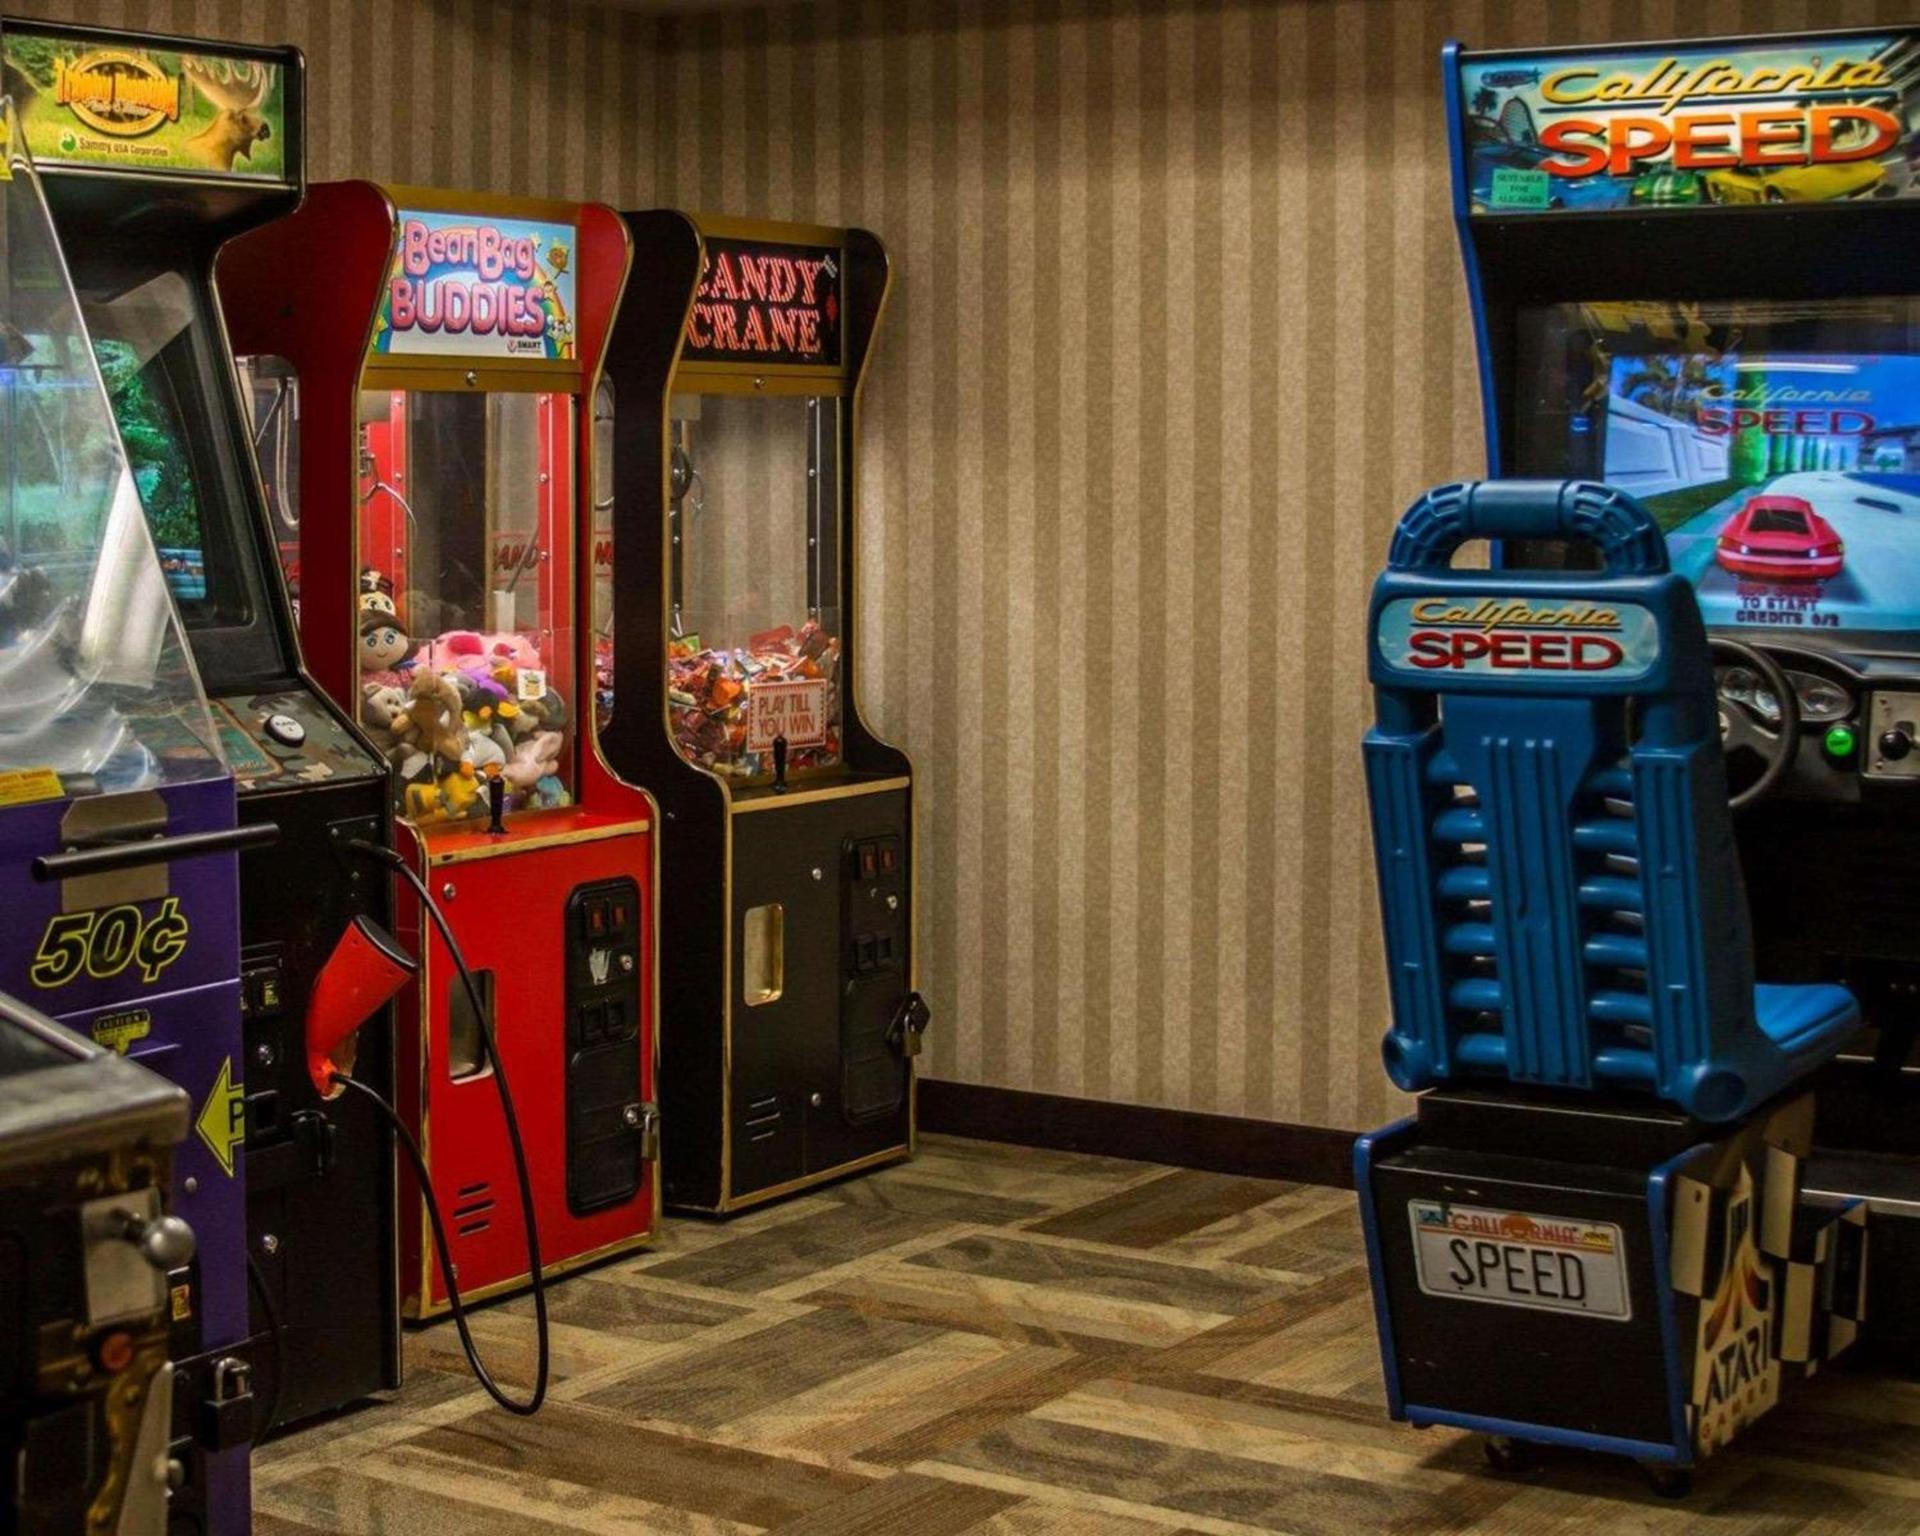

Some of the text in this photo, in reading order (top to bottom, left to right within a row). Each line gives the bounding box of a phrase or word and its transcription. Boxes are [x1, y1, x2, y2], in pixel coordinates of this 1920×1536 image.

[1538, 56, 1892, 116] California
[79, 137, 169, 157] Sammy USA Corporation
[1537, 105, 1900, 178] SPEED
[391, 278, 546, 338] BUDDIES
[517, 340, 542, 349] SMART
[687, 302, 822, 354] CRANE
[1701, 382, 1873, 404] California
[1696, 409, 1876, 437] SPEED
[1410, 599, 1622, 633] California
[1736, 609, 1803, 625] CREDITS
[1742, 597, 1817, 611] TO START
[1407, 630, 1625, 671] SPEED
[758, 693, 810, 715] PLAY TILL
[759, 714, 816, 737] YOU WIN
[31, 898, 189, 988] 50¢
[1450, 1238, 1587, 1301] SPEED
[1703, 1318, 1769, 1416] ATARI
